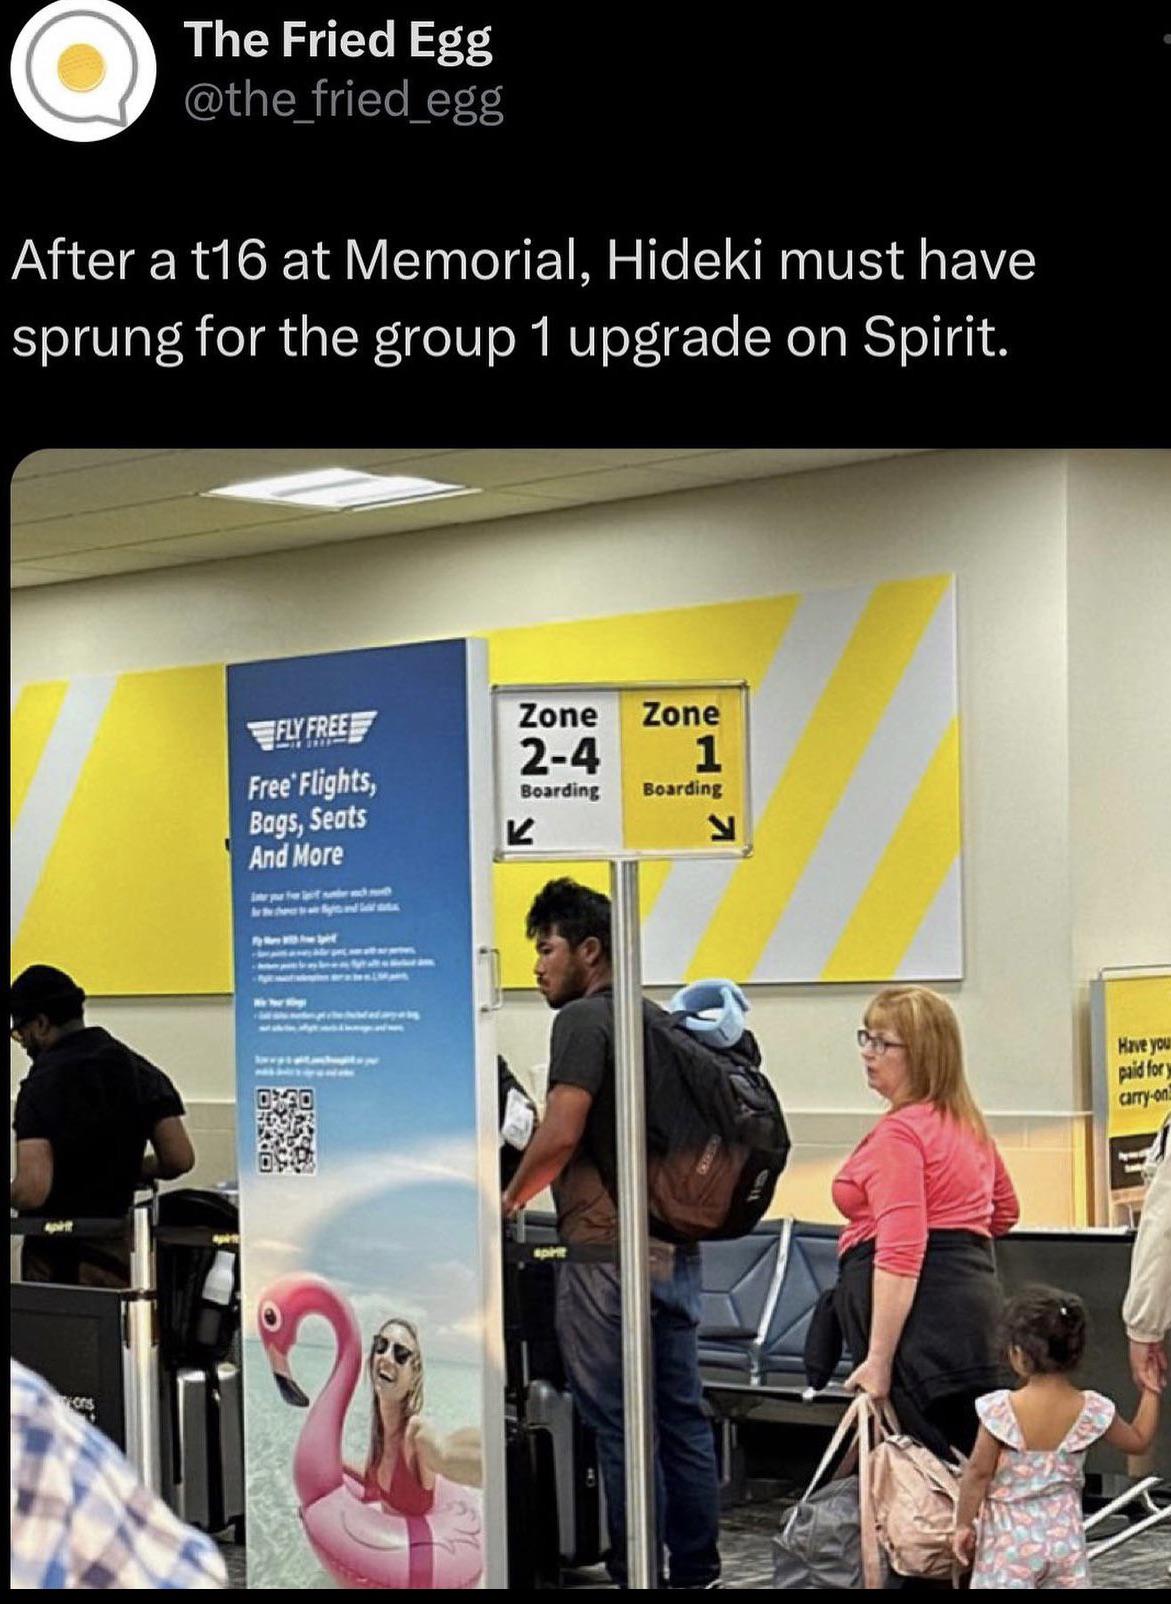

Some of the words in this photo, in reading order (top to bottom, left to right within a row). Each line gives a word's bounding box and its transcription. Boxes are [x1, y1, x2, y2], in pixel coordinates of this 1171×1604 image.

[276, 717, 305, 741] FLY
[306, 712, 349, 738] FREE
[519, 702, 598, 729] Zone
[643, 701, 720, 728] Zone
[520, 735, 600, 776] 2-4
[696, 734, 722, 773] 1
[299, 766, 377, 801] Flights,
[521, 782, 600, 801] Boarding
[643, 780, 723, 799] Boarding
[250, 811, 304, 840] Bags,
[309, 805, 368, 831] Seats
[249, 842, 290, 871] And
[292, 842, 344, 868] More
[1118, 1036, 1148, 1055] Have
[1119, 1059, 1144, 1085] paid
[1147, 1059, 1165, 1079] for
[45, 1220, 73, 1234] spirit
[533, 1246, 567, 1261] spirit
